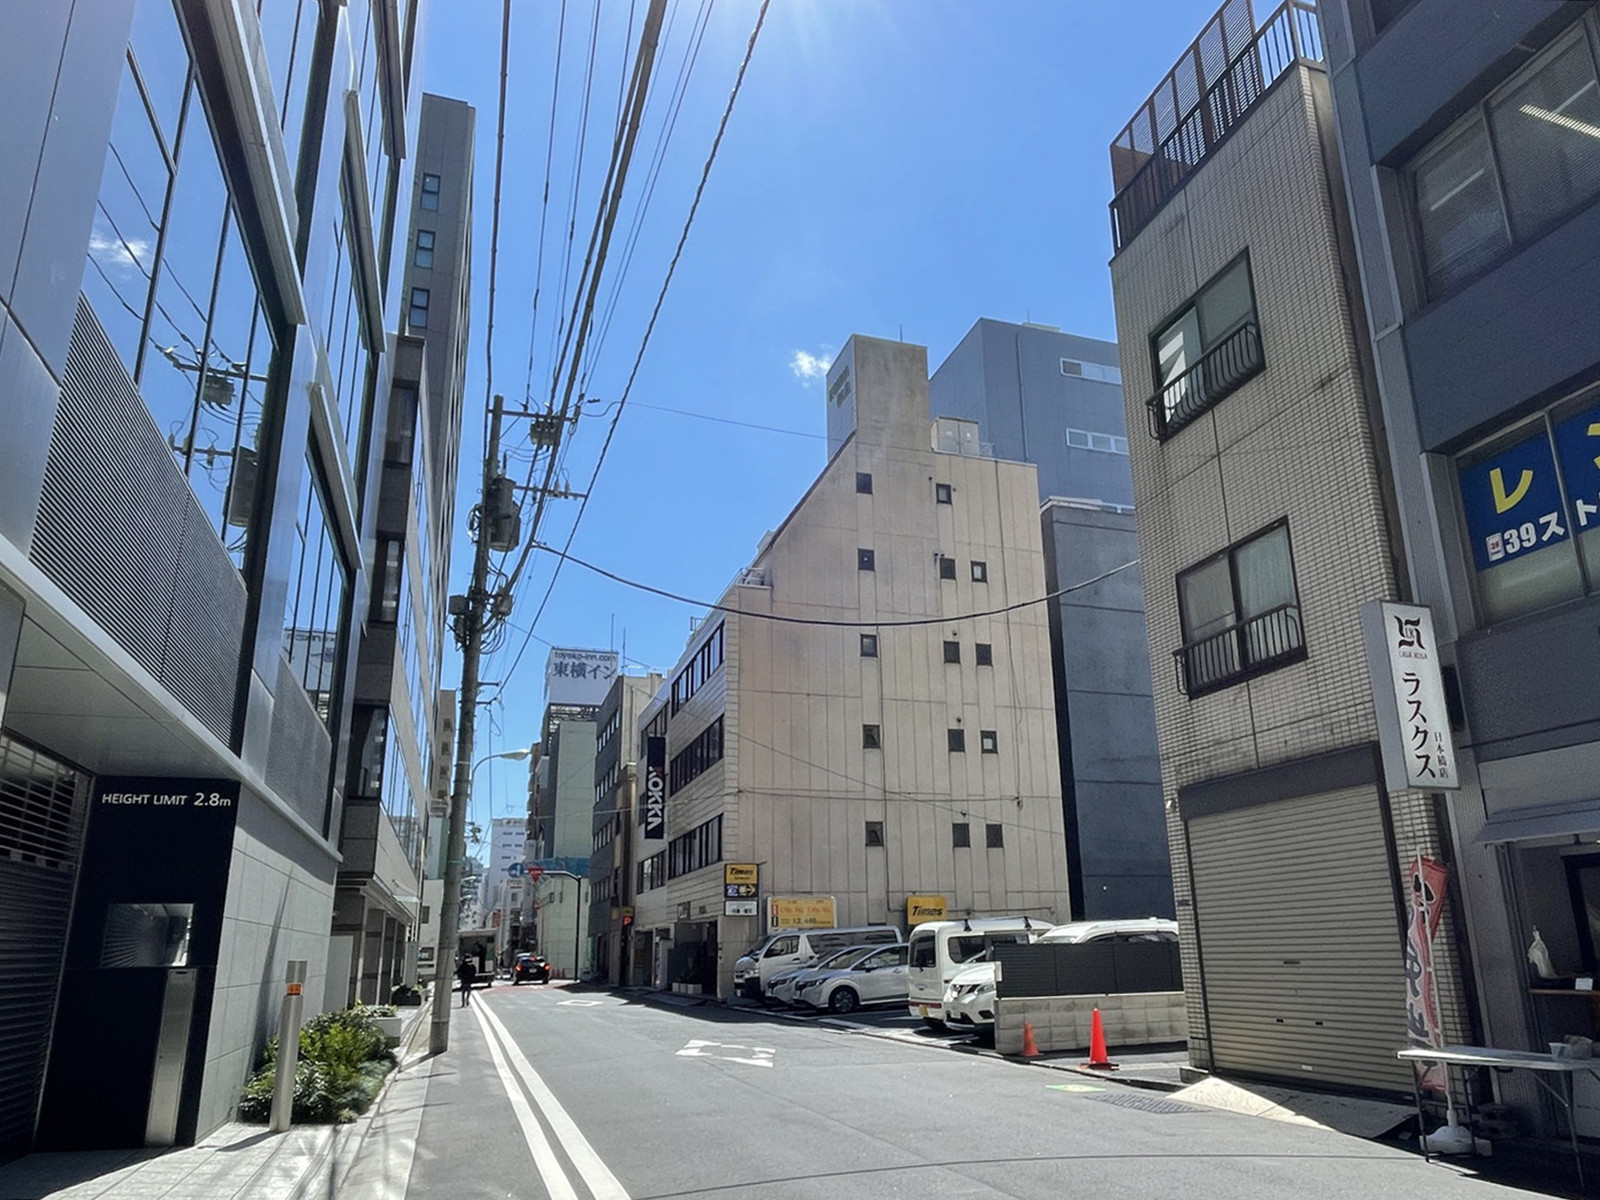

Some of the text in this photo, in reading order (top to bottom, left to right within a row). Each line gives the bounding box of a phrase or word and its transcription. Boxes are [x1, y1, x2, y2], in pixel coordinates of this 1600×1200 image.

[554, 651, 616, 662] toyoko-inn.com
[552, 661, 617, 680] 東横イン
[1402, 672, 1436, 778] ラスクス
[102, 792, 231, 807] HEIGHT LIMIT 2.8m
[912, 905, 943, 917] Times
